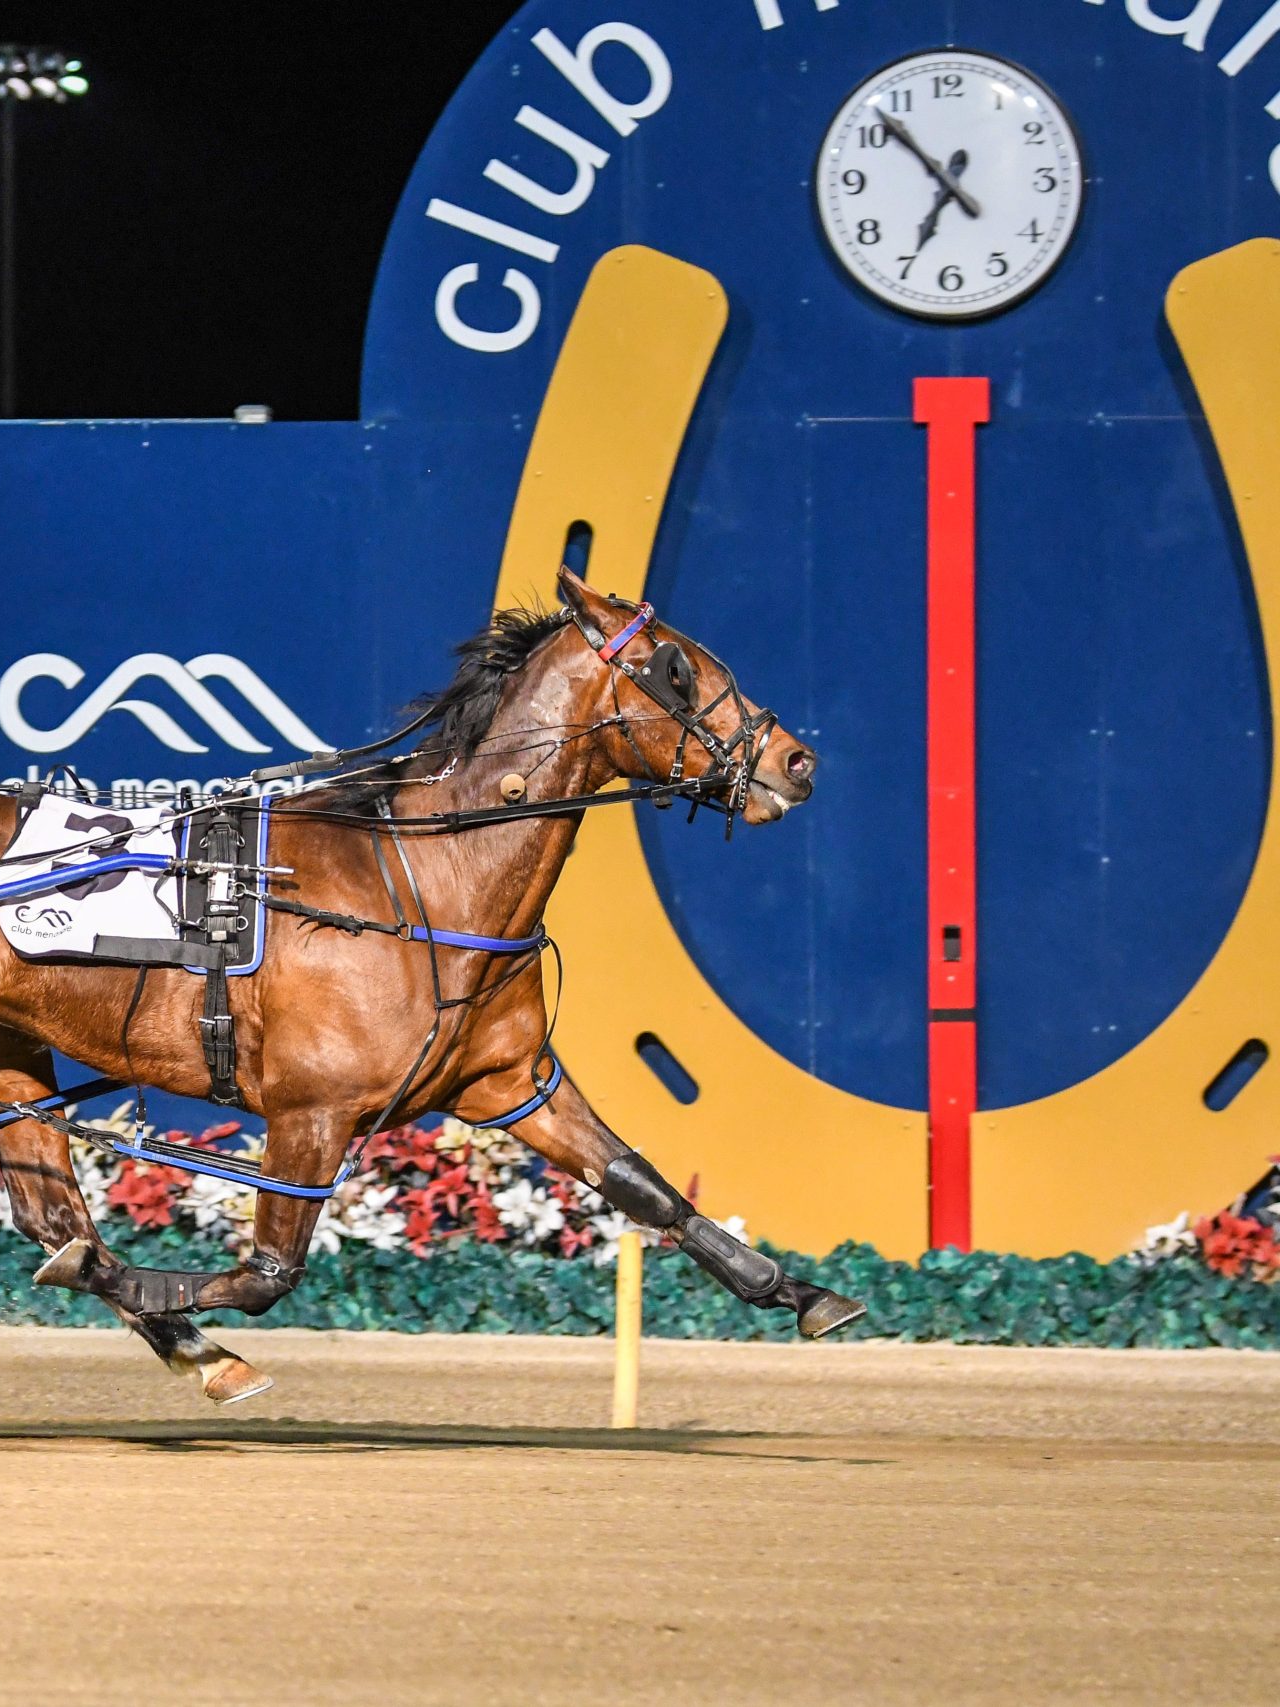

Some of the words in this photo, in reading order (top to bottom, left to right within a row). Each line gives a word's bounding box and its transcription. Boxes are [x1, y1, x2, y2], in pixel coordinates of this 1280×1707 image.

[933, 74, 964, 98] 12
[890, 89, 913, 113] 11
[857, 123, 889, 149] 10
[1022, 121, 1046, 146] 2
[425, 21, 674, 353] club
[842, 169, 866, 195] 9
[1033, 167, 1058, 193] 3
[857, 218, 881, 245] 8
[1015, 218, 1044, 243] 4
[897, 254, 918, 280] 7
[985, 252, 1009, 277] 5
[938, 265, 964, 291] 6
[11, 925, 32, 935] club
